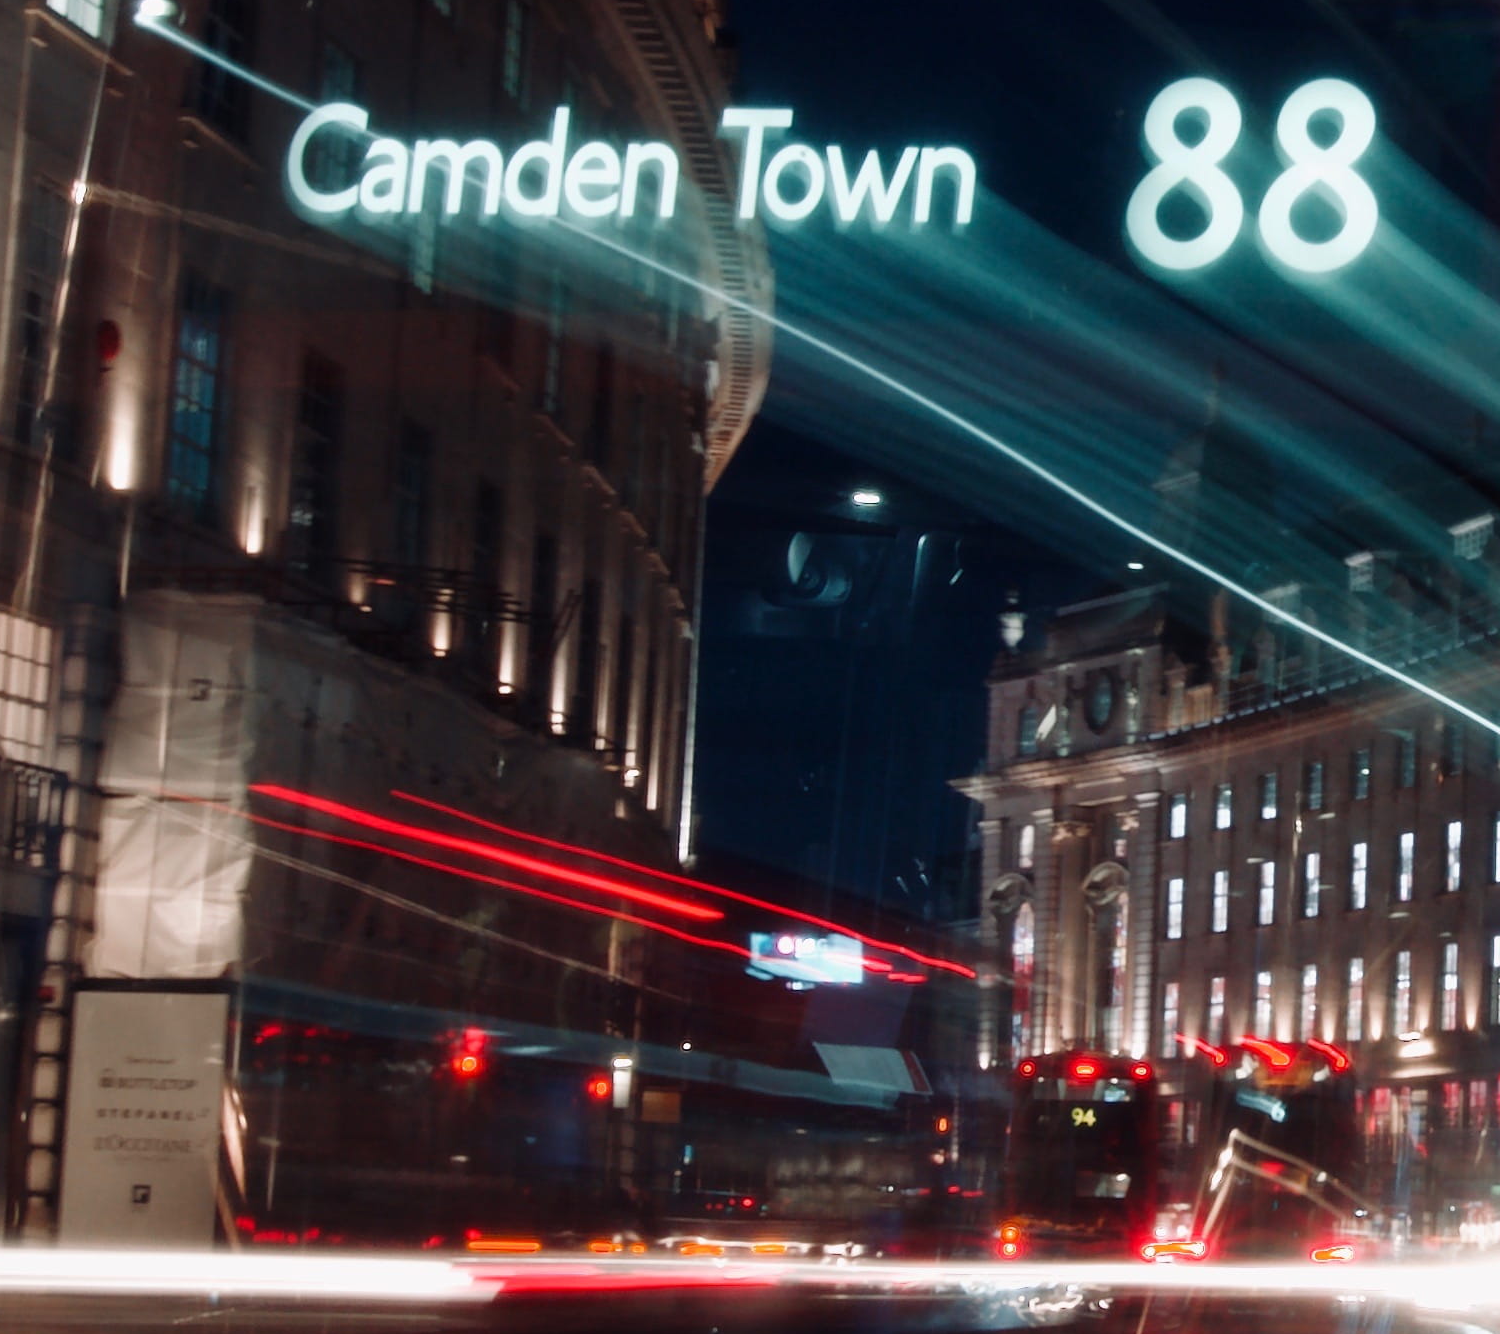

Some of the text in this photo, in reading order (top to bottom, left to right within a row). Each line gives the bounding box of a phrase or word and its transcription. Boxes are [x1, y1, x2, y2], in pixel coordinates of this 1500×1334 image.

[288, 78, 1379, 275] Camden Town 88
[1071, 1107, 1097, 1128] 94
